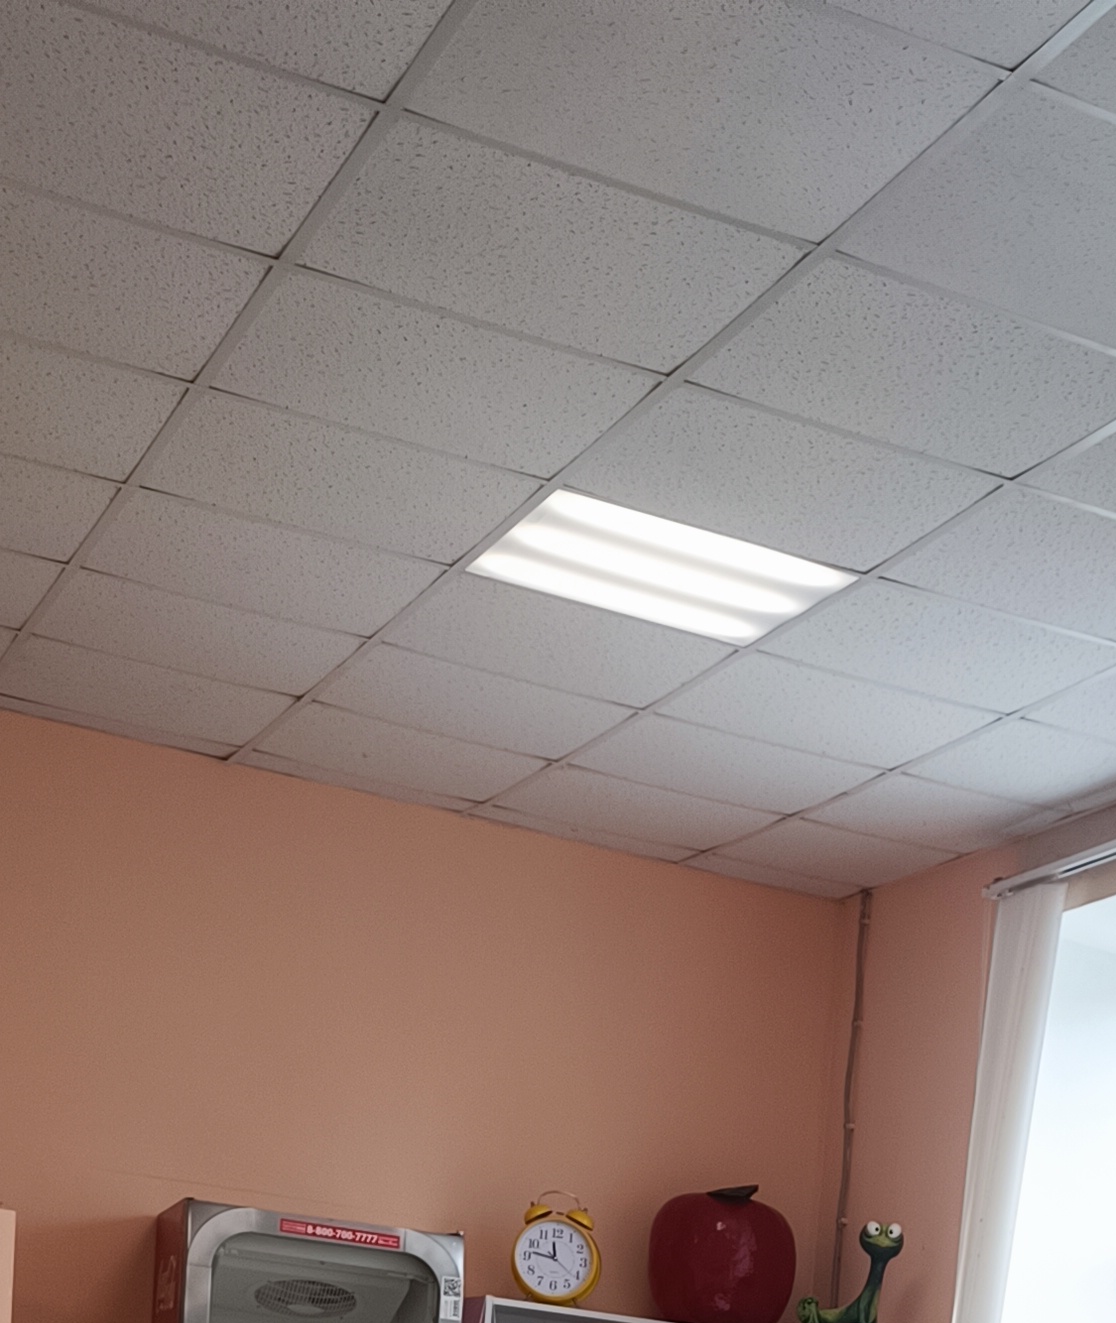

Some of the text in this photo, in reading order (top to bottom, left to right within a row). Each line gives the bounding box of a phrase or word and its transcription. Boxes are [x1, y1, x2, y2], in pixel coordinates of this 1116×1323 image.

[539, 1229, 548, 1240] 11
[552, 1228, 564, 1239] 12
[528, 1238, 540, 1249] 10
[576, 1244, 584, 1254] 2
[523, 1250, 531, 1261] 9
[579, 1258, 587, 1268] 3
[527, 1265, 535, 1275] 8
[537, 1276, 544, 1286] 7
[549, 1280, 557, 1291] 6
[563, 1279, 571, 1289] 5
